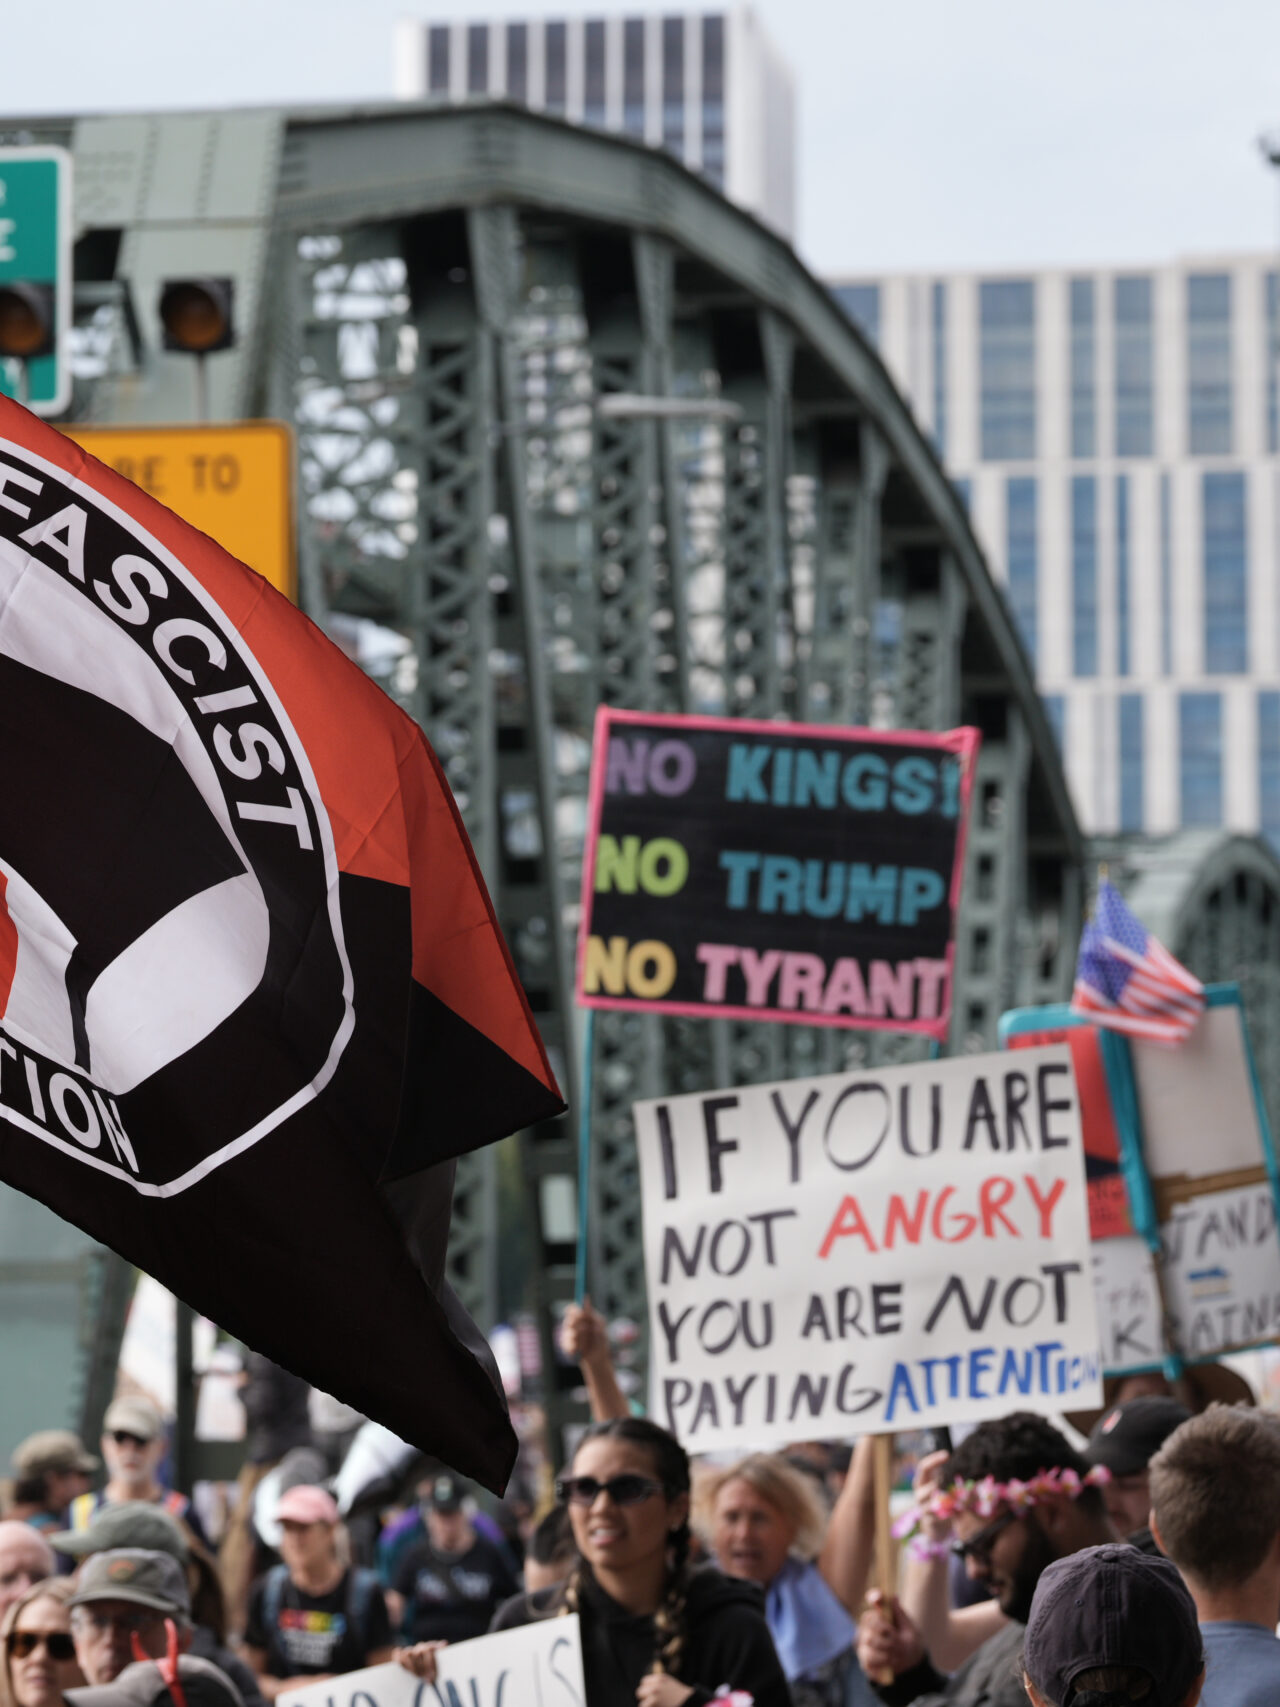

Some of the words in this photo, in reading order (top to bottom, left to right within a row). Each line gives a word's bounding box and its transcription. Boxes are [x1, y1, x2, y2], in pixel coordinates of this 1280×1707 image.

[190, 453, 241, 495] TO
[604, 738, 697, 797] NO
[726, 743, 961, 818] KINGS!
[594, 835, 690, 897] NO
[720, 850, 946, 926] TRUMP
[584, 936, 677, 999] NO
[697, 942, 951, 1019] TYRANT
[656, 1096, 740, 1200] IF
[771, 1081, 942, 1184] YOU
[963, 1063, 1072, 1153] ARE
[659, 1208, 798, 1285] NOT
[817, 1174, 1068, 1259] ANGRY
[657, 1298, 775, 1364] YOU
[801, 1282, 904, 1342] ARE
[924, 1262, 1082, 1335] NOT
[661, 1362, 883, 1438] PAYING
